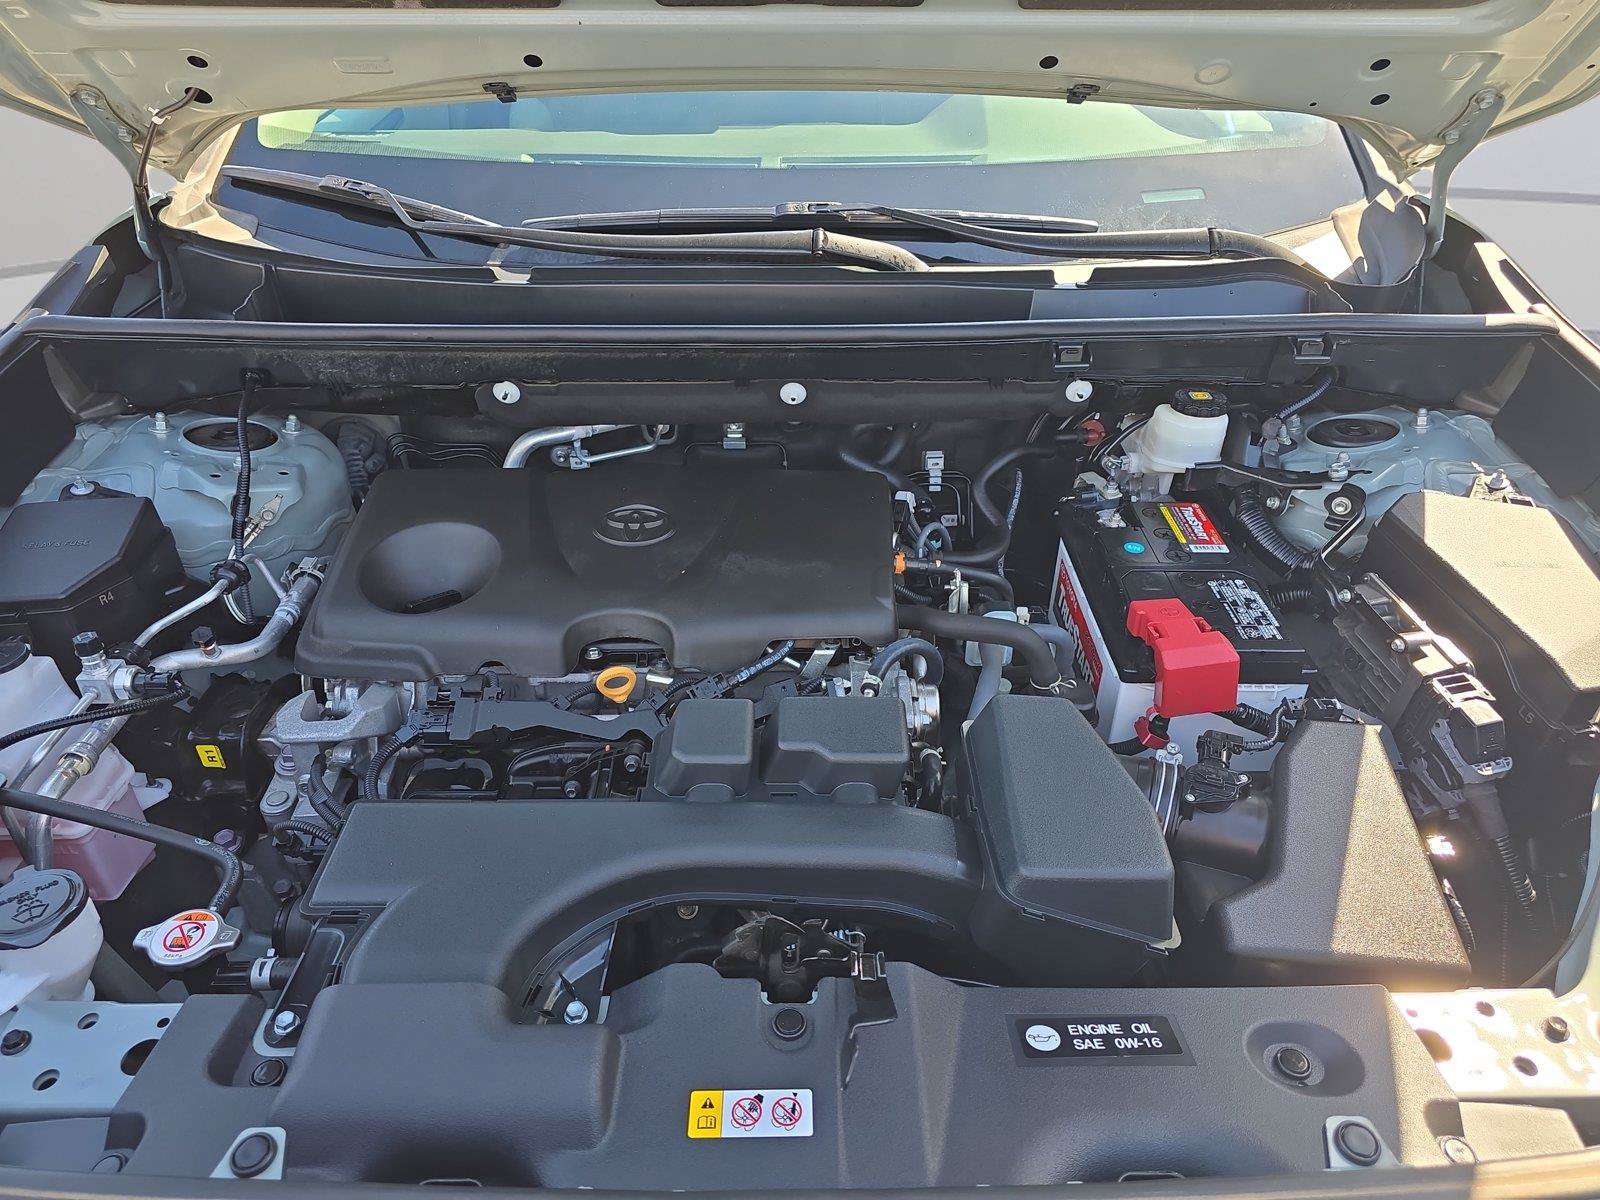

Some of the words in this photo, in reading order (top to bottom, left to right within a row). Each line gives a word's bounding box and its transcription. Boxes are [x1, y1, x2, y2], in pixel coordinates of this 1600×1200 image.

[98, 591, 115, 606] R4
[204, 750, 218, 762] R1
[1067, 1023, 1123, 1036] ENGINE
[1131, 1022, 1158, 1034] OIL
[1073, 1038, 1106, 1050] SAE
[1115, 1037, 1163, 1049] 0W-16
